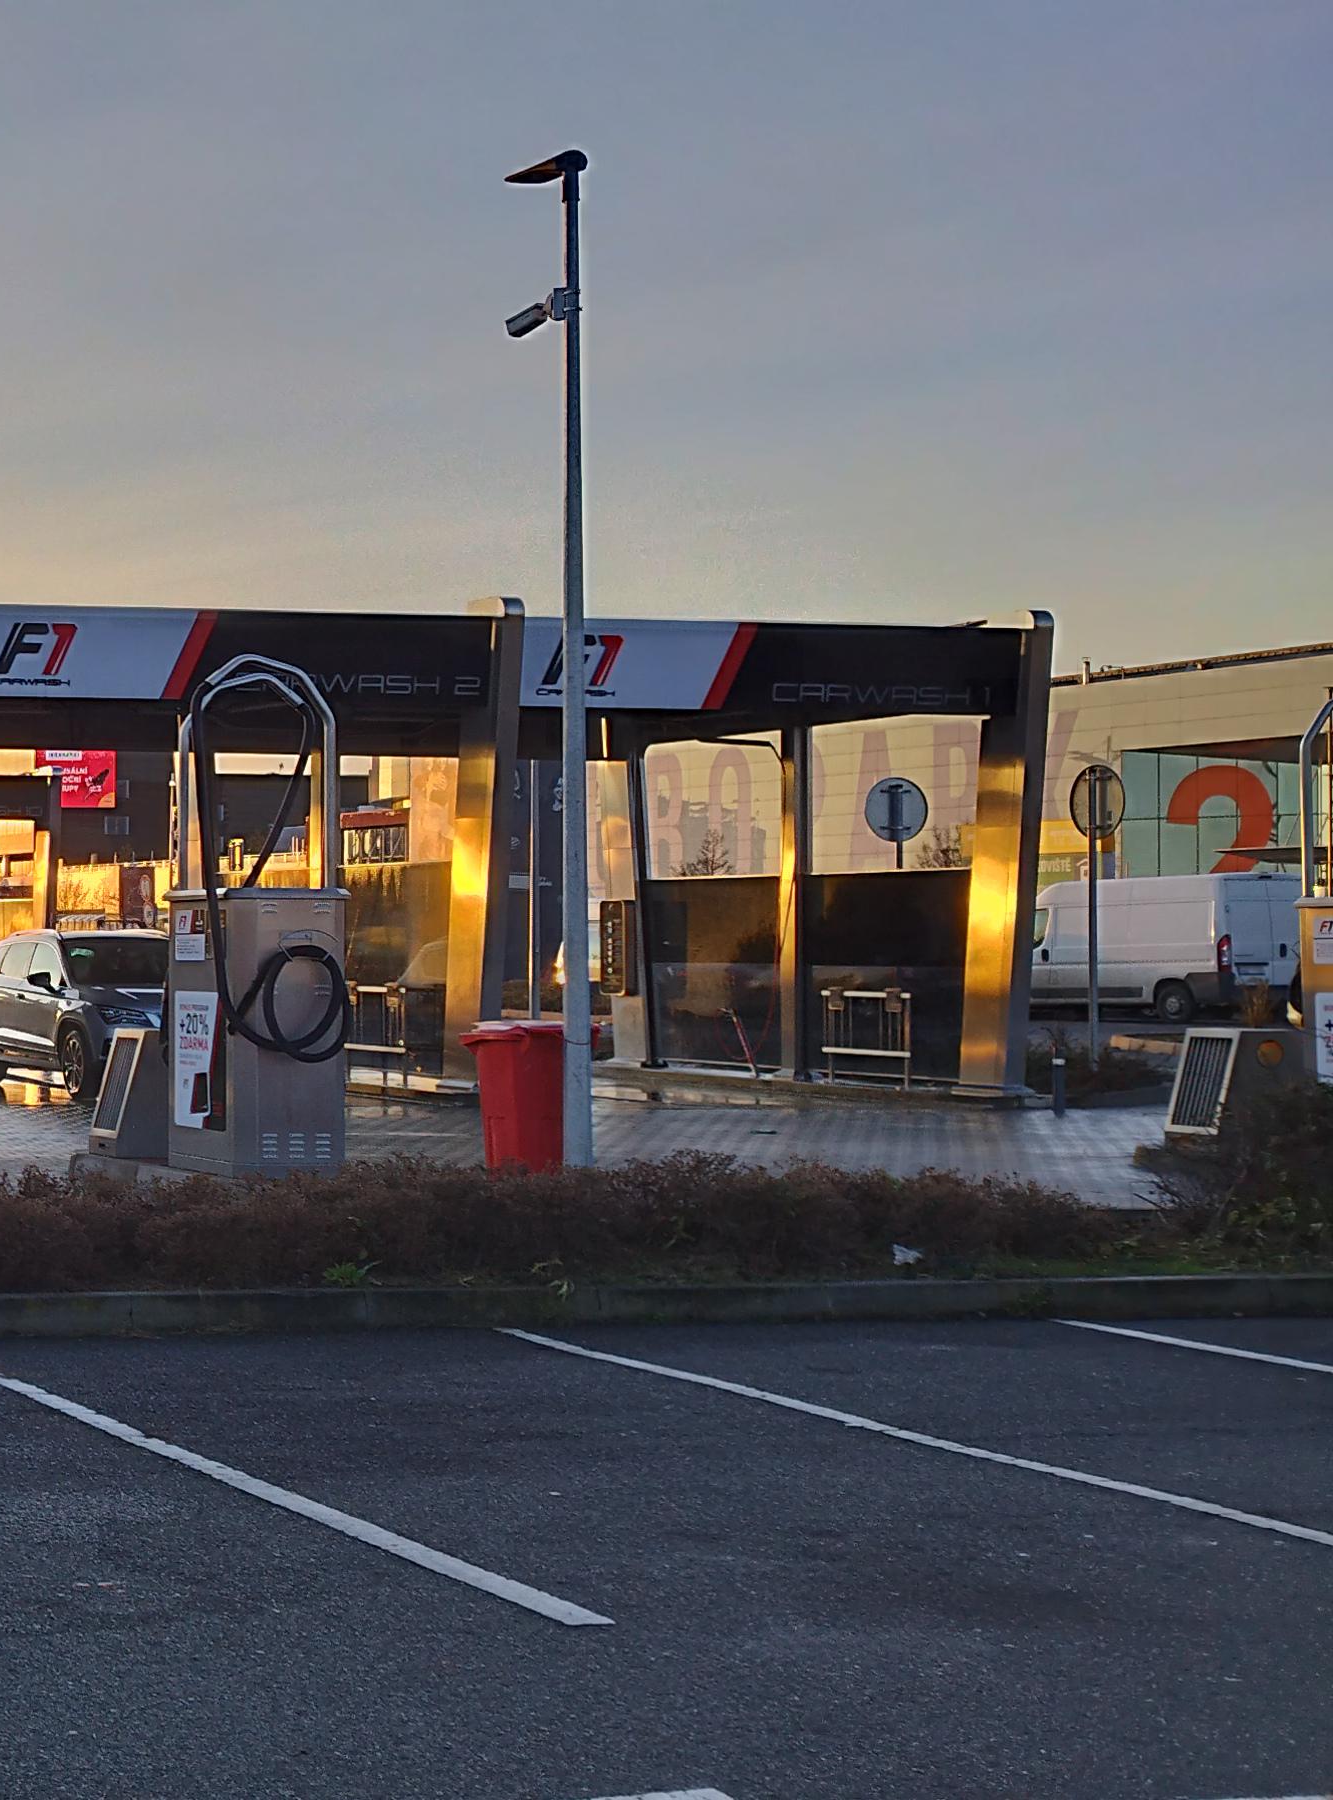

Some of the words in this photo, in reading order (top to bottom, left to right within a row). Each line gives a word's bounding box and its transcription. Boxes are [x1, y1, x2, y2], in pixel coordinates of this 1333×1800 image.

[453, 675, 481, 696] 2
[536, 688, 616, 697] CASH
[772, 682, 970, 706] CARWASH
